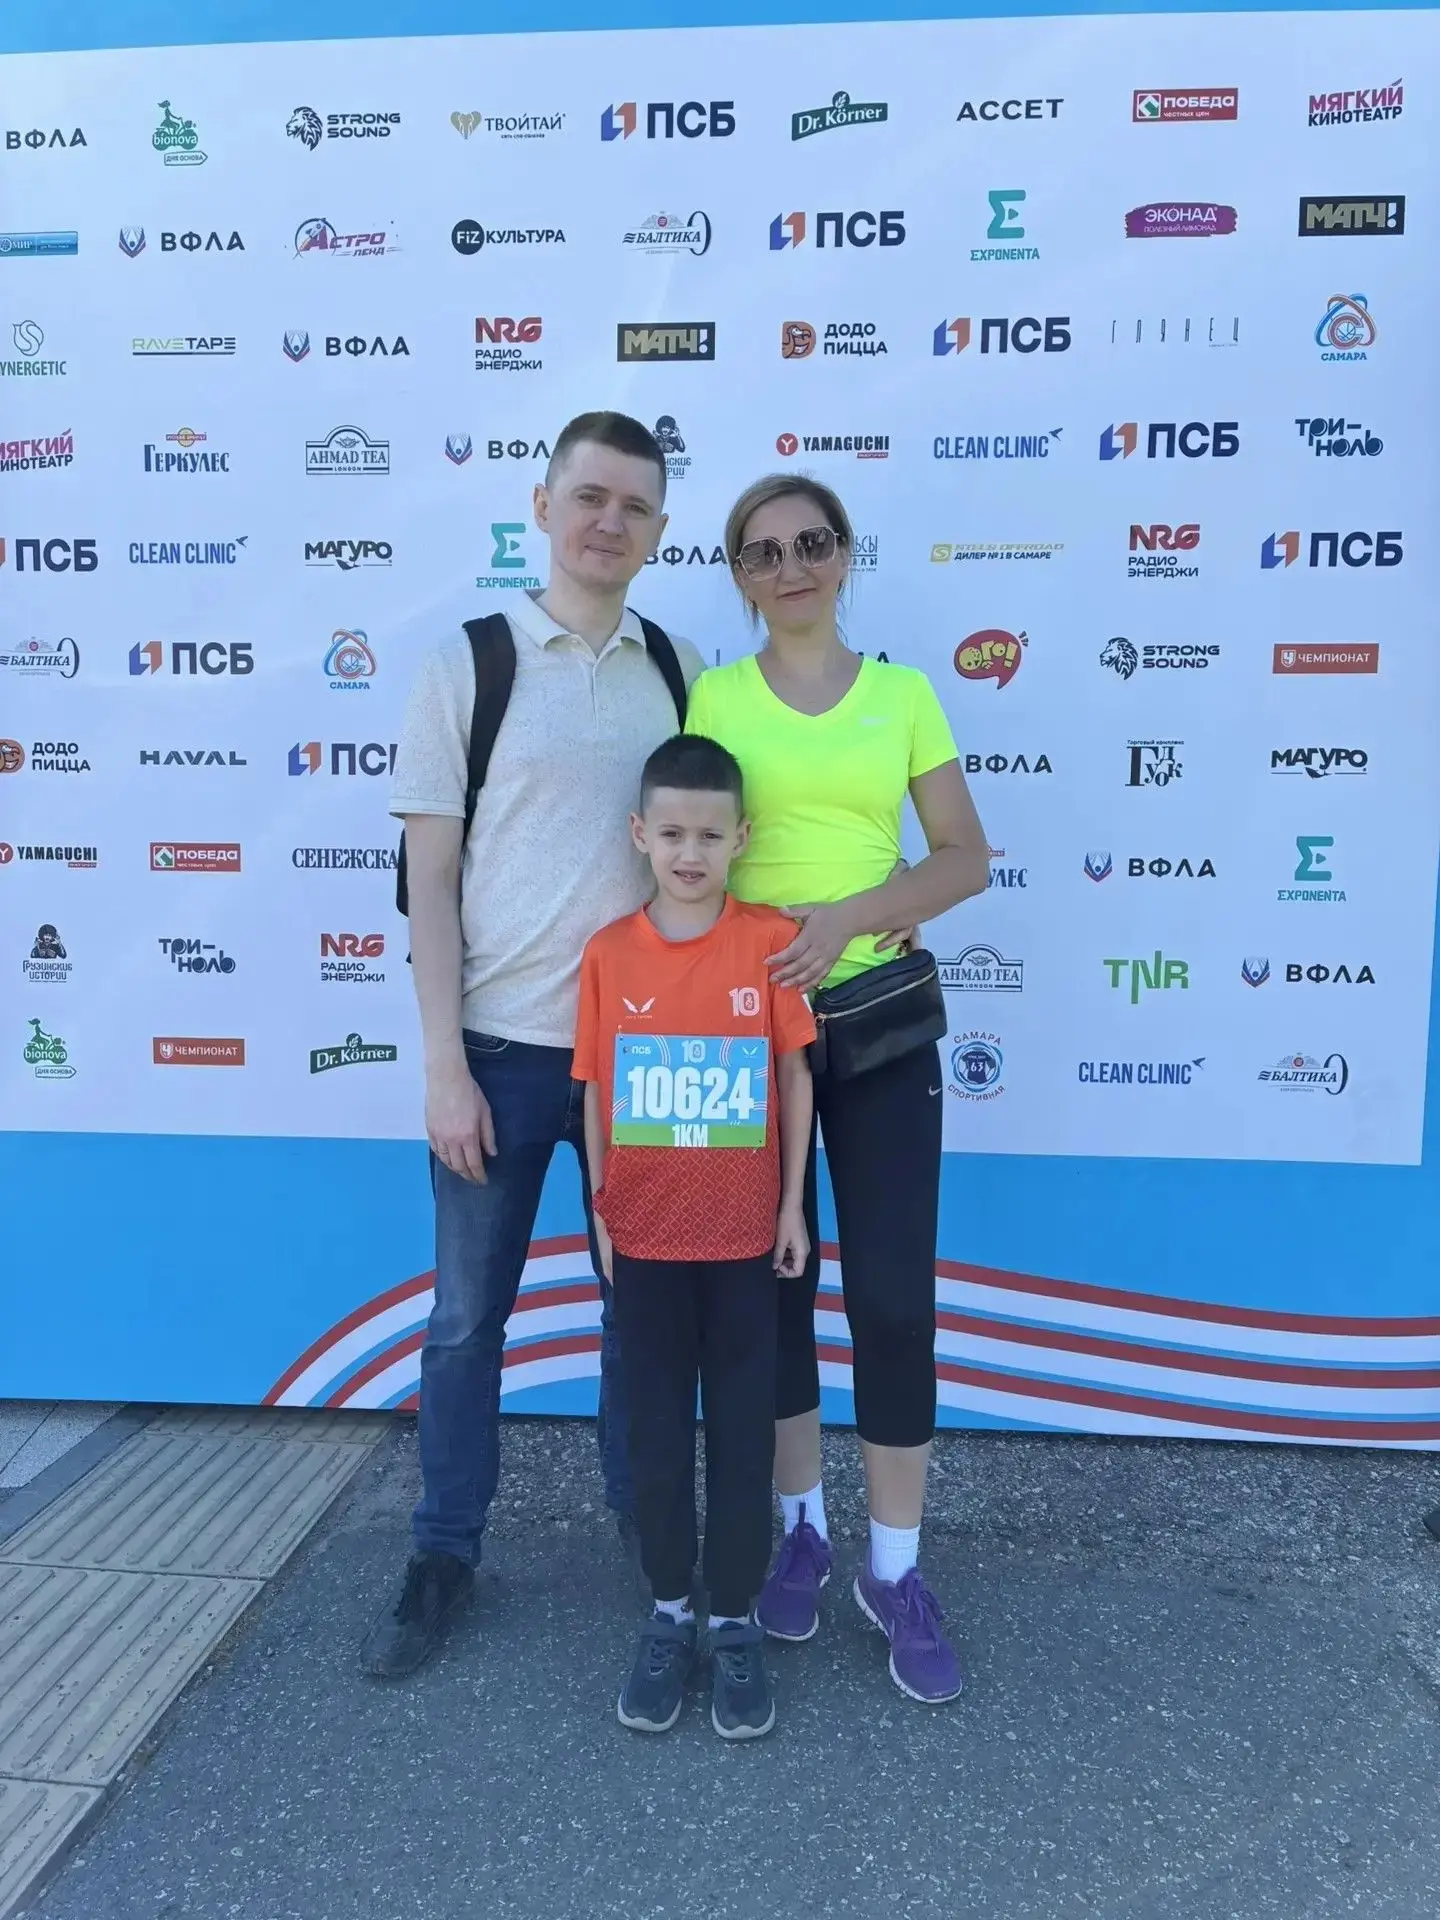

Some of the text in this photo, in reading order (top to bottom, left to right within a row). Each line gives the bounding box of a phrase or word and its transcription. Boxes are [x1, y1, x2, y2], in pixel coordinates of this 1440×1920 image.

[1309, 78, 1403, 113] МЯГКИЙ
[326, 112, 400, 126] STRONG
[647, 101, 736, 138] ПСБ
[798, 105, 883, 134] Dr. Körner
[1308, 106, 1403, 126] КИНОТЕАТР
[6, 128, 87, 150] ВФЛА
[153, 133, 198, 147] bionova
[327, 127, 391, 138] SOUND
[1145, 206, 1218, 223] ЭКОНАД
[1306, 203, 1397, 229] МАТЧ!
[635, 230, 701, 245] БАЛТИКА
[816, 211, 906, 248] ПСБ
[161, 231, 245, 251] ВФЛА
[475, 317, 543, 344] NRG
[824, 324, 876, 338] ДОДО
[981, 317, 1072, 354] ПСБ
[325, 336, 411, 357] ВФЛА
[624, 330, 709, 355] МАТЧ!
[824, 340, 888, 356] ПИЦЦА
[475, 350, 522, 361] РАДИО
[1321, 352, 1368, 362] САМАРА
[0, 361, 67, 376] YNERGETIC
[475, 361, 543, 372] ЭНЕРДЖИ
[803, 436, 890, 451] YAMAGUCHI
[934, 435, 1049, 459] CLEAN CLINIC
[1147, 422, 1240, 458] ПСБ
[309, 450, 387, 464] AHMAD TEA
[488, 440, 551, 459] ВФЛ
[0, 454, 73, 472] ИНОТЕАТР
[1129, 524, 1200, 551] NRG
[15, 539, 98, 572] ПСБ
[129, 542, 236, 564] CLEAN CLINIC
[305, 541, 392, 561] МАГУРО
[954, 551, 988, 561] ДИЛЕР
[1015, 551, 1052, 560] САМАРЕ
[1309, 531, 1403, 567] ПСБ
[1128, 557, 1177, 568] РАДИО
[1128, 568, 1199, 578] ЭНЕРДЖИ
[172, 642, 254, 675] ПСБ
[1143, 645, 1220, 656] STRONG
[1298, 653, 1370, 663] ЧЕМПИОНАТ
[10, 655, 71, 667] БАЛТИКА
[1142, 658, 1208, 669] SOUND
[330, 682, 370, 690] САМАРА
[32, 742, 79, 756] ДОДО
[32, 759, 91, 773] ПИЦЦА
[140, 751, 247, 766] HAVAL
[965, 754, 1053, 774] ВФЛА
[1271, 748, 1368, 768] МАГУРО
[17, 846, 97, 861] YAMAGUCHI
[292, 848, 398, 869] СЕНЕЖСКА
[1128, 858, 1216, 877] ВФЛА
[321, 933, 384, 957] NRG
[29, 971, 67, 981] ИСТОРИИ
[321, 963, 365, 973] РАДИО
[941, 968, 1020, 982] AHMAD TEA
[1103, 950, 1189, 1003] TNR
[1286, 964, 1375, 984] ВФЛА
[321, 973, 384, 982] ЭНЕРДЖИ
[953, 1032, 1001, 1046] САМАРА
[25, 1048, 66, 1061] bionova
[175, 1047, 237, 1056] ЧЕМПИОНАТ
[316, 1047, 392, 1069] Dr. Körner
[1079, 1062, 1191, 1085] CLEAN CLINIC
[1271, 1069, 1337, 1083] БАЛТИКА
[628, 1066, 754, 1120] 10624
[947, 1084, 1005, 1102] СПОРТИВНАЯ
